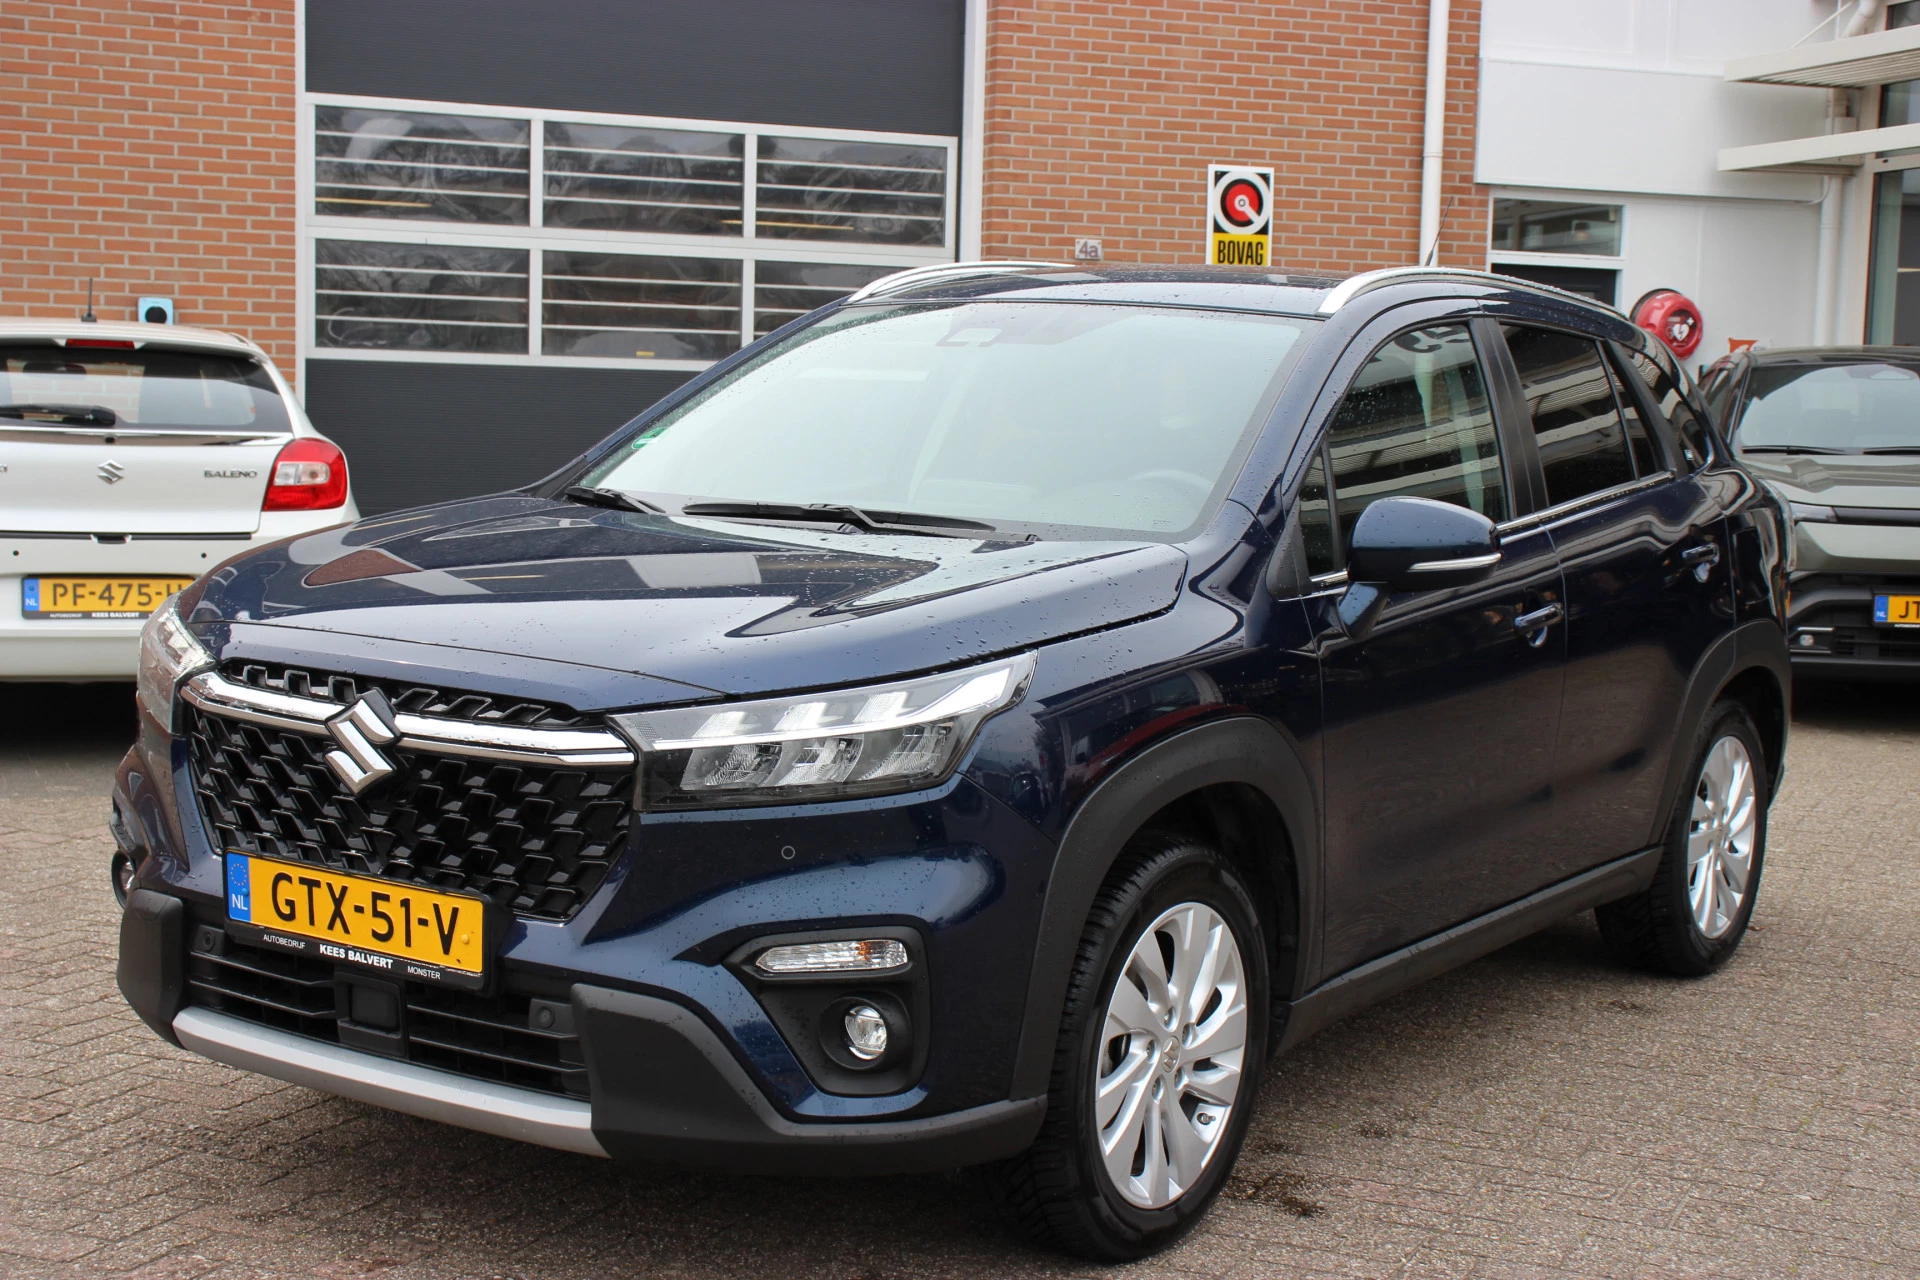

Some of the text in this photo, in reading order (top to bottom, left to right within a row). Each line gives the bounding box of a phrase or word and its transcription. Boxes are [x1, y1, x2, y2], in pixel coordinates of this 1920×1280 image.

[1078, 241, 1099, 259] 4a
[1217, 240, 1264, 266] BOVAG
[204, 470, 258, 478] BALENO
[232, 893, 248, 911] NL
[271, 872, 459, 955] GTX-51-V
[263, 934, 441, 980] AUTOBEDRIJF KEES BALVERT MONSTER
